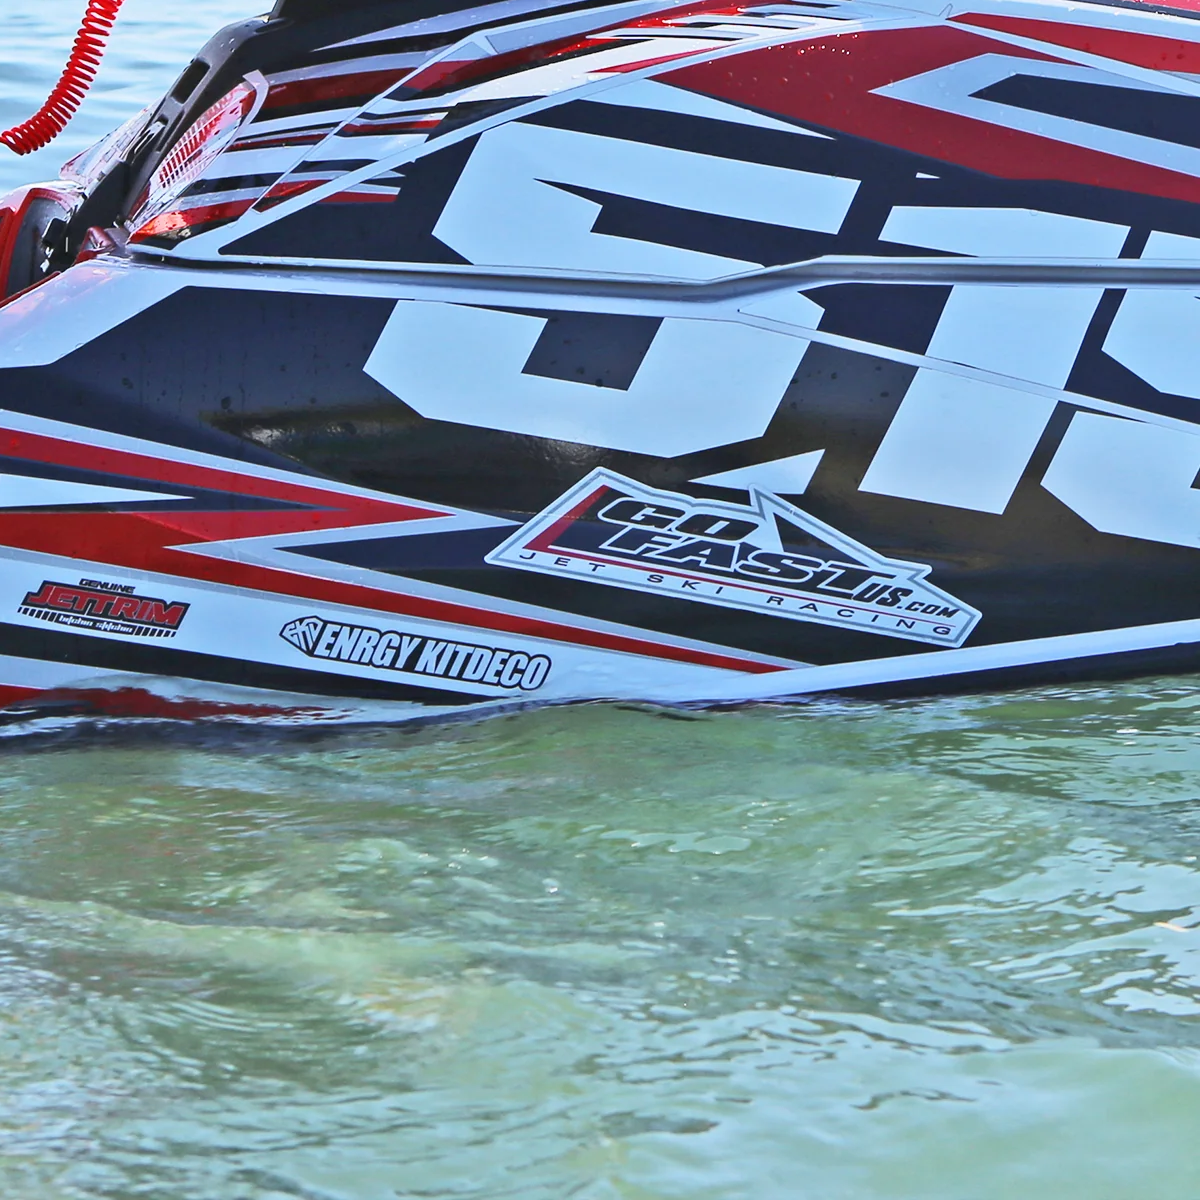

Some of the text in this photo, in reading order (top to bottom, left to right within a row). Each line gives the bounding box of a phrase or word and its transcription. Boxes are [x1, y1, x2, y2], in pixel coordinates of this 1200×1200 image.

[599, 498, 760, 540] GO
[25, 584, 186, 627] JETTRIM
[79, 578, 136, 594] GENUINE
[519, 554, 952, 636] JET SKI RACING
[313, 623, 423, 670] ENRGY
[413, 638, 551, 691] KITDECO
